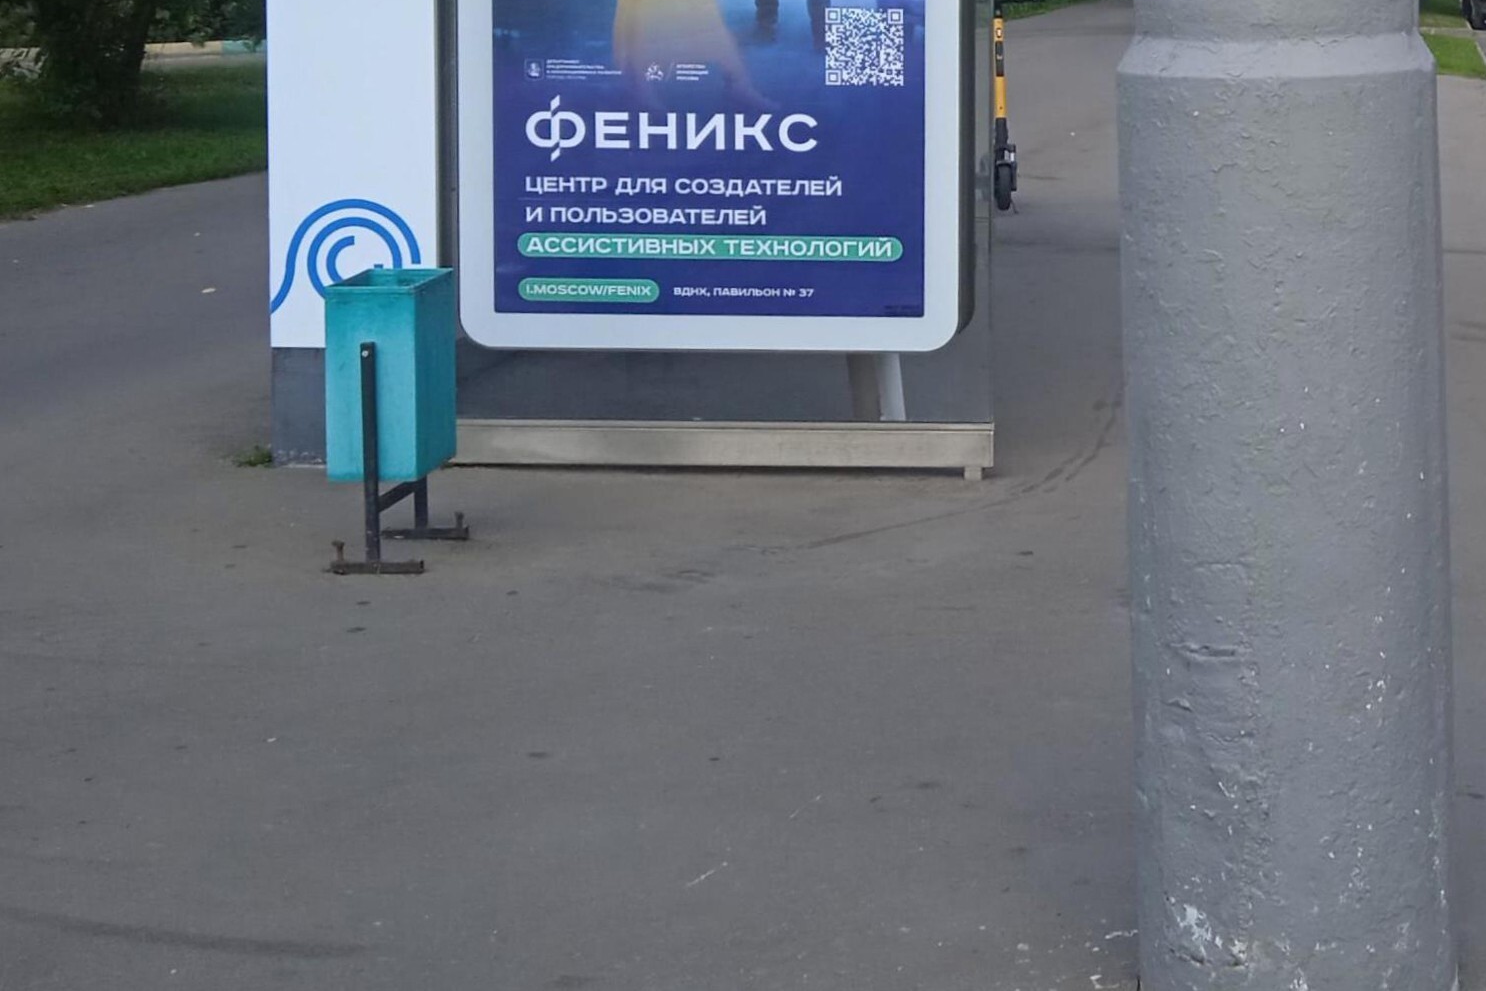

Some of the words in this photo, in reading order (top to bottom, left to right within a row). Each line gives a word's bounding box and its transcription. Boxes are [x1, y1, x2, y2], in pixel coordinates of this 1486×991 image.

[525, 94, 818, 162] ФЕНИКС
[525, 176, 607, 194] ЦЕНТР
[615, 177, 667, 196] ДЛЯ
[674, 175, 843, 197] СОЗДАТЕЛЕЙ
[525, 207, 543, 223] И
[550, 205, 767, 226] ПОЛЬЗОВАТЕЛЕЙ
[526, 236, 716, 256] АССИСТИВНЫХ
[724, 236, 893, 258] ТЕХНОЛОГИЙ
[673, 287, 711, 298] ВДНХ,
[713, 287, 781, 297] ПАВИЛЬОН
[798, 288, 815, 297] 37
